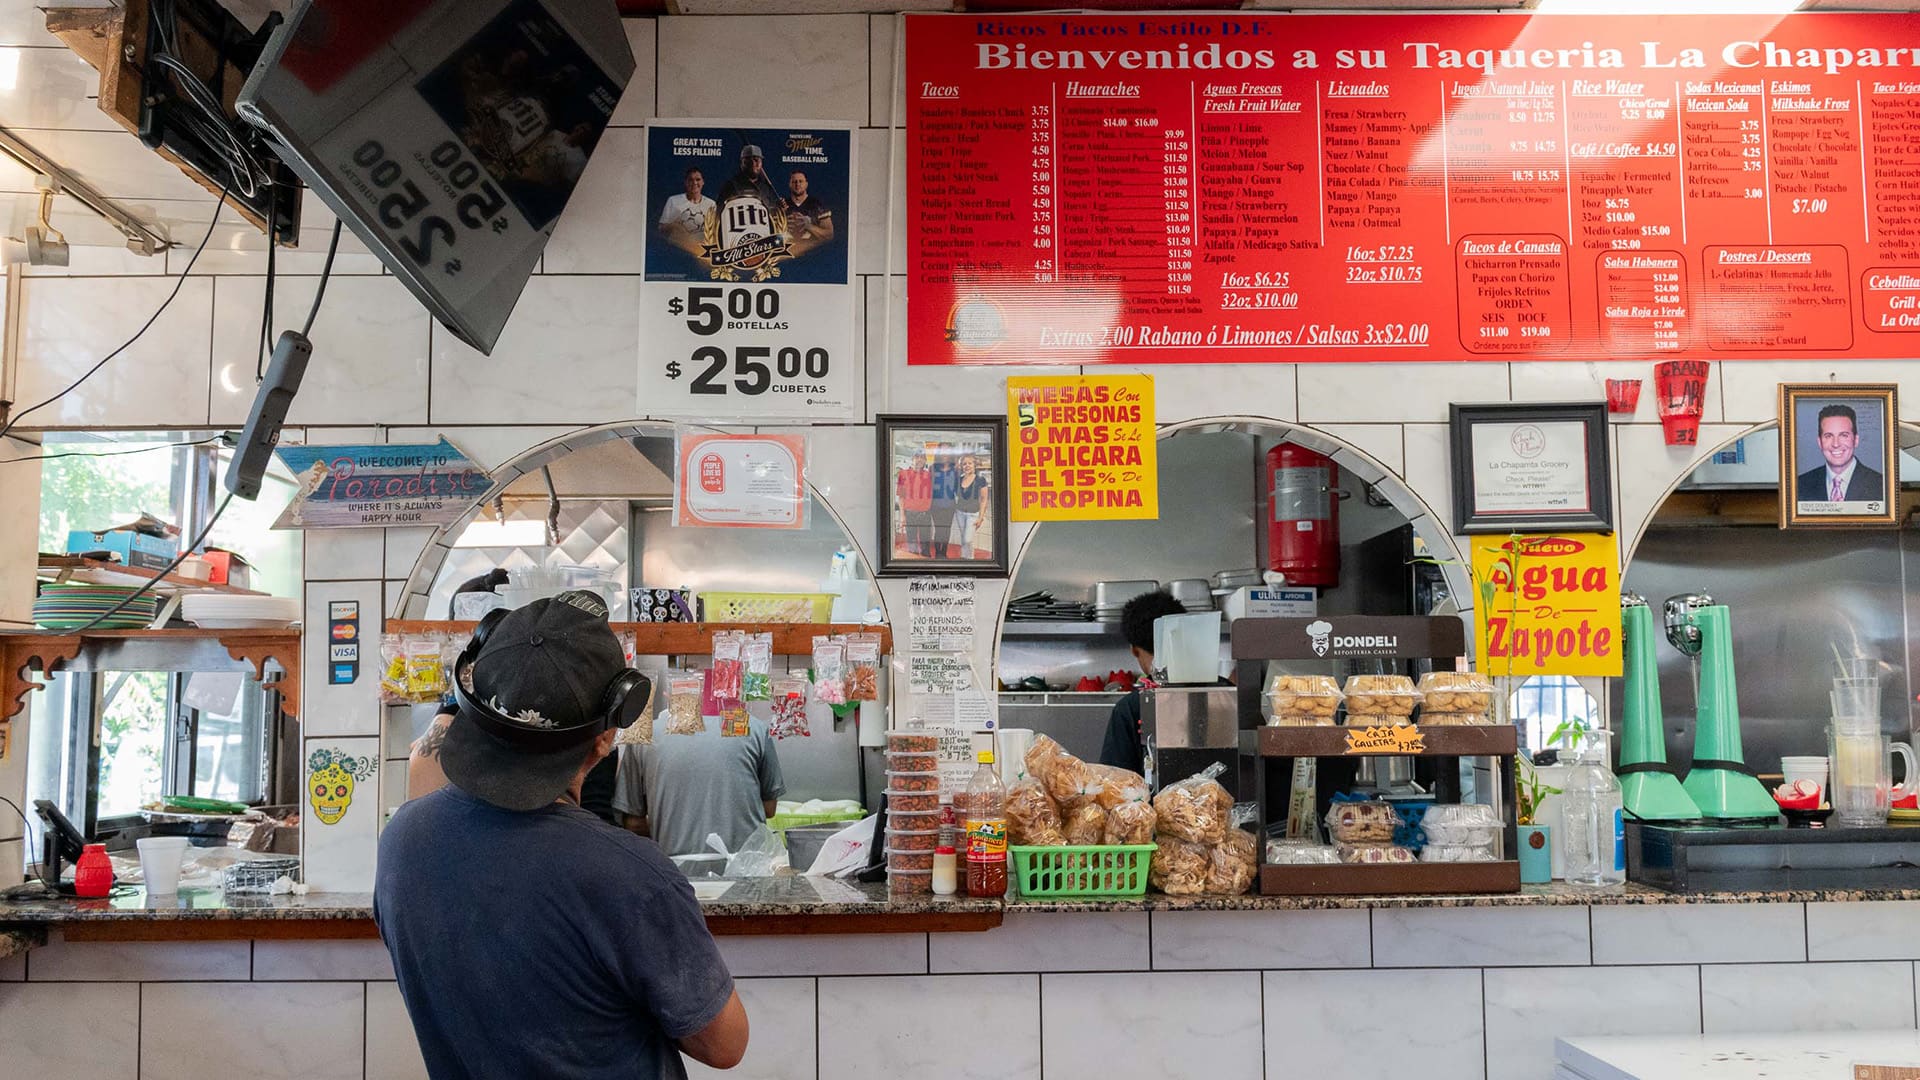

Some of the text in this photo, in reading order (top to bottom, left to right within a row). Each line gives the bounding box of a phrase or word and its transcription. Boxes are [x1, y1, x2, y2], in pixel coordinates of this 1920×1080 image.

[976, 22, 1272, 36] Ricos Tacos Estilo D.F.
[975, 43, 1275, 70] Bienvenidos
[1293, 50, 1319, 69] a
[1336, 50, 1387, 69] su
[1403, 42, 1624, 75] Taqueria
[1640, 42, 1706, 68] La
[922, 82, 959, 96] Tacos
[1066, 81, 1140, 96] Huaraches
[1204, 83, 1282, 95] Aguas Frescas
[1328, 81, 1389, 95] Licuados
[1489, 82, 1526, 94] Natural
[1529, 82, 1554, 95] Juice
[1573, 81, 1644, 94] Rice Water
[1685, 82, 1761, 93] Sodas Mexicanas
[1771, 82, 1811, 93] Eskimos
[1873, 82, 1895, 92] Taco
[1204, 99, 1301, 111] Fresh Fruit Water
[1687, 99, 1749, 111] Mexican Soda
[1772, 99, 1849, 110] Milkshake Frost
[1032, 106, 1049, 116] 3.75
[1325, 110, 1348, 119] Fresa
[1357, 110, 1407, 120] Strawberry
[1032, 119, 1049, 128] 3.75
[674, 138, 722, 147] GREAT TASTE
[1032, 132, 1049, 142] 3.75
[674, 148, 722, 156] LESS FILLING
[1032, 146, 1049, 155] 4.50
[1164, 142, 1188, 151] $11.50
[1571, 144, 1596, 155] Café
[1605, 143, 1640, 158] Coffee
[1646, 143, 1675, 155] $4.50
[1032, 159, 1050, 168] 4.75
[1032, 172, 1050, 182] 5.00
[1032, 186, 1050, 195] 5.50
[1032, 199, 1050, 208] 4.50
[1793, 199, 1827, 213] $7.00
[728, 204, 768, 232] Lite
[1166, 225, 1190, 234] $10.49
[1583, 226, 1670, 235] Medio Galon $15.00
[724, 241, 773, 263] All Stars
[1463, 241, 1561, 253] Tacos de Canasta
[1203, 253, 1235, 263] Zapote
[1346, 246, 1413, 261] 16oz $7.25
[1719, 251, 1758, 262] Postres
[1768, 251, 1811, 262] Desserts
[1465, 260, 1560, 269] Chicharron Prensado
[1605, 257, 1677, 267] Salsa Habanera
[1347, 266, 1422, 281] 32oz $10.75
[1221, 272, 1289, 287] 16oz $6.25
[1478, 287, 1550, 296] Frijoles Refritos
[1222, 293, 1251, 307] 32oz
[1254, 292, 1298, 308] $10.00
[1495, 300, 1533, 308] ORDEN
[1890, 296, 1915, 309] Grill
[1605, 307, 1629, 316] Salsa
[1631, 307, 1650, 316] Roja
[1661, 307, 1685, 316] Verde
[1482, 313, 1504, 322] SEIS
[728, 322, 788, 330] BOTELLAS
[1040, 327, 1094, 346] Extras
[1099, 327, 1133, 346] 2.00
[1138, 325, 1202, 346] Rabano
[1207, 326, 1217, 345] ó
[1222, 326, 1292, 345] Limones
[1307, 326, 1359, 345] Salsas
[1365, 324, 1429, 344] 3x$2.00
[1480, 327, 1550, 337] $11.00 $19.00
[772, 385, 826, 393] CUBETAS
[1019, 387, 1139, 403] MESAS Con
[1019, 405, 1140, 426] 5 PERSONAS
[1020, 426, 1141, 444] O MAS Se Le
[359, 456, 447, 467] WELCOME TO
[1020, 446, 1142, 467] APLICARA
[329, 457, 473, 502] Paradise
[1022, 469, 1142, 487] EL 15% De
[1022, 490, 1143, 508] PROPINA
[348, 502, 442, 511] WHERE IT'S ALWAYS
[362, 513, 422, 522] HAPPY HOUR
[1492, 558, 1608, 600] Agua
[1534, 606, 1561, 619] De
[1334, 636, 1397, 647] DONDELI
[1488, 618, 1610, 667] Zapote
[1367, 730, 1395, 738] CAJA
[1354, 739, 1395, 748] GALLETAS
